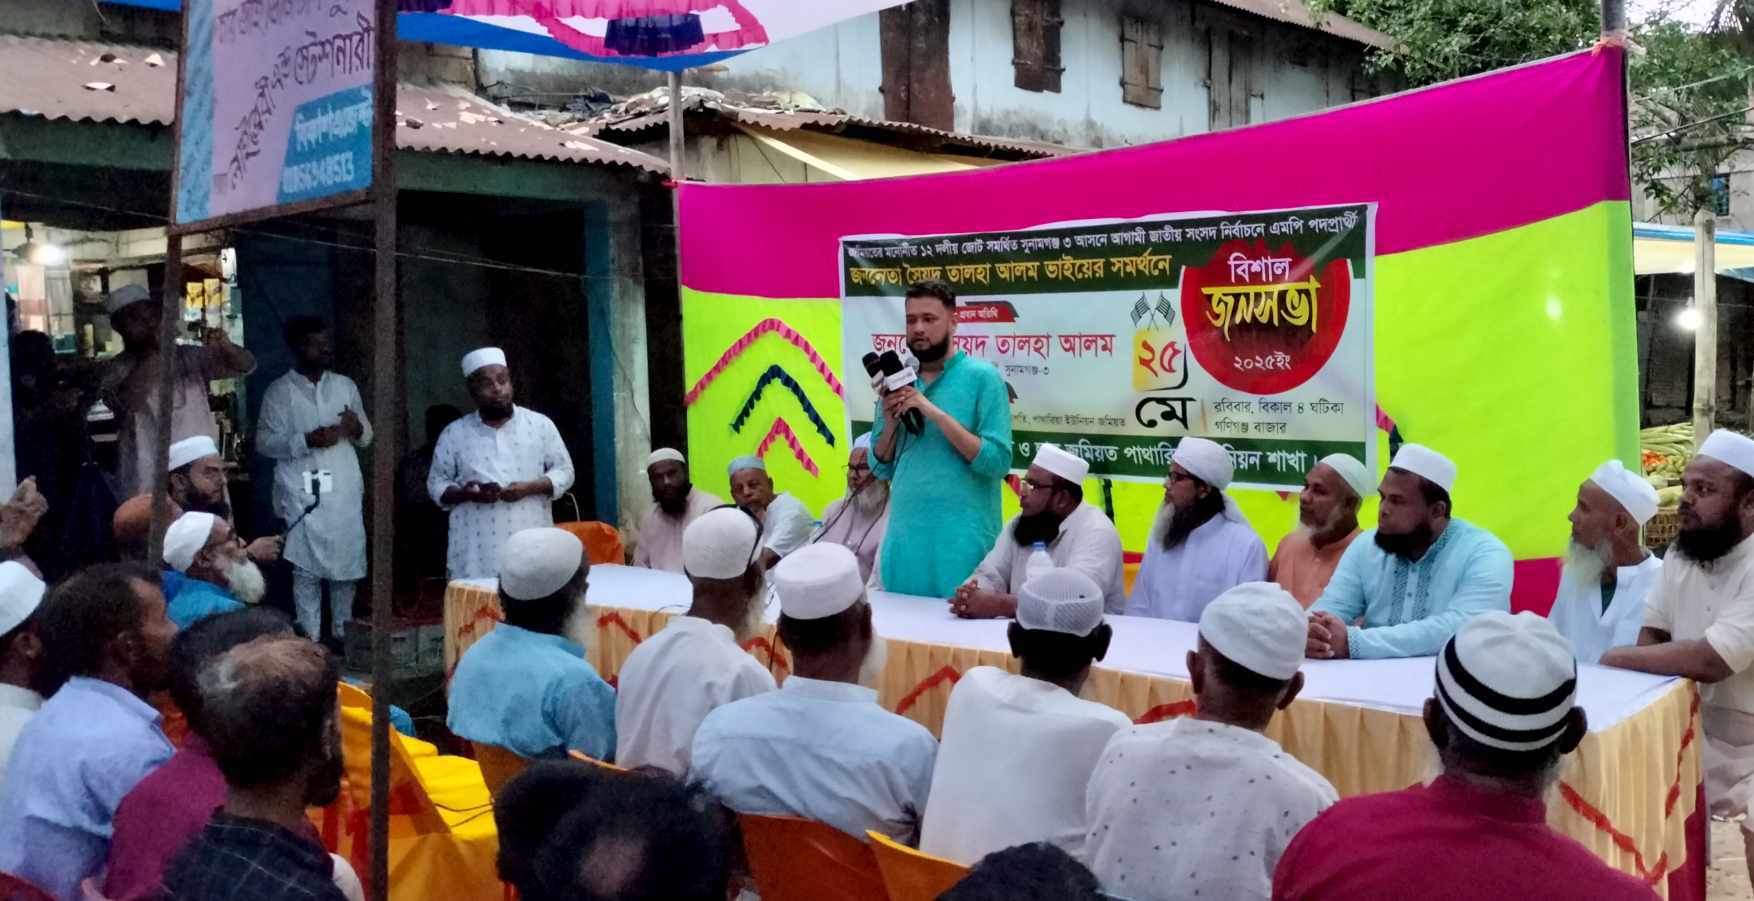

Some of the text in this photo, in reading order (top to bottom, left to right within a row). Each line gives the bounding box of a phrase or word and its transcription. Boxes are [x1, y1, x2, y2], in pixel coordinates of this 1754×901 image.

[885, 242, 918, 258] মনোনীত
[920, 245, 933, 257] ১২
[935, 239, 959, 256] দলীয়
[961, 238, 983, 256] জোট
[986, 235, 1018, 253] সমর্থিত
[1021, 237, 1059, 254] সুনামগঞ্জ
[1063, 239, 1071, 249] ৩
[1073, 232, 1106, 247] আসনে
[1111, 226, 1146, 246] আগামী
[1149, 224, 1183, 243] জাতীয়
[1186, 225, 1216, 242] সংসদ
[1221, 219, 1265, 240] নির্বাচনে
[1270, 215, 1303, 235] এমপি
[1309, 211, 1359, 233] পদপ্রার্থী
[903, 261, 943, 284] সৈয়দ
[945, 263, 992, 285] তালহা
[995, 260, 1040, 282] আলম
[1043, 253, 1104, 282] ভাইয়ের
[1110, 248, 1172, 277] সমর্থনে
[1228, 252, 1293, 283] বিশাল
[1201, 275, 1321, 342] জনসভা
[995, 331, 1052, 360] তালহা
[1058, 331, 1116, 360] আলম
[1138, 339, 1184, 378] ২৫
[1233, 351, 1292, 371] ২০২৫ইং
[1135, 396, 1197, 430] মে
[1257, 397, 1293, 414] বিকাল
[1297, 402, 1304, 414] ৪
[1309, 397, 1344, 414] ঘটিকা
[1253, 419, 1287, 434] বাজার
[1018, 442, 1031, 457] ও
[1266, 450, 1307, 473] শাখা
